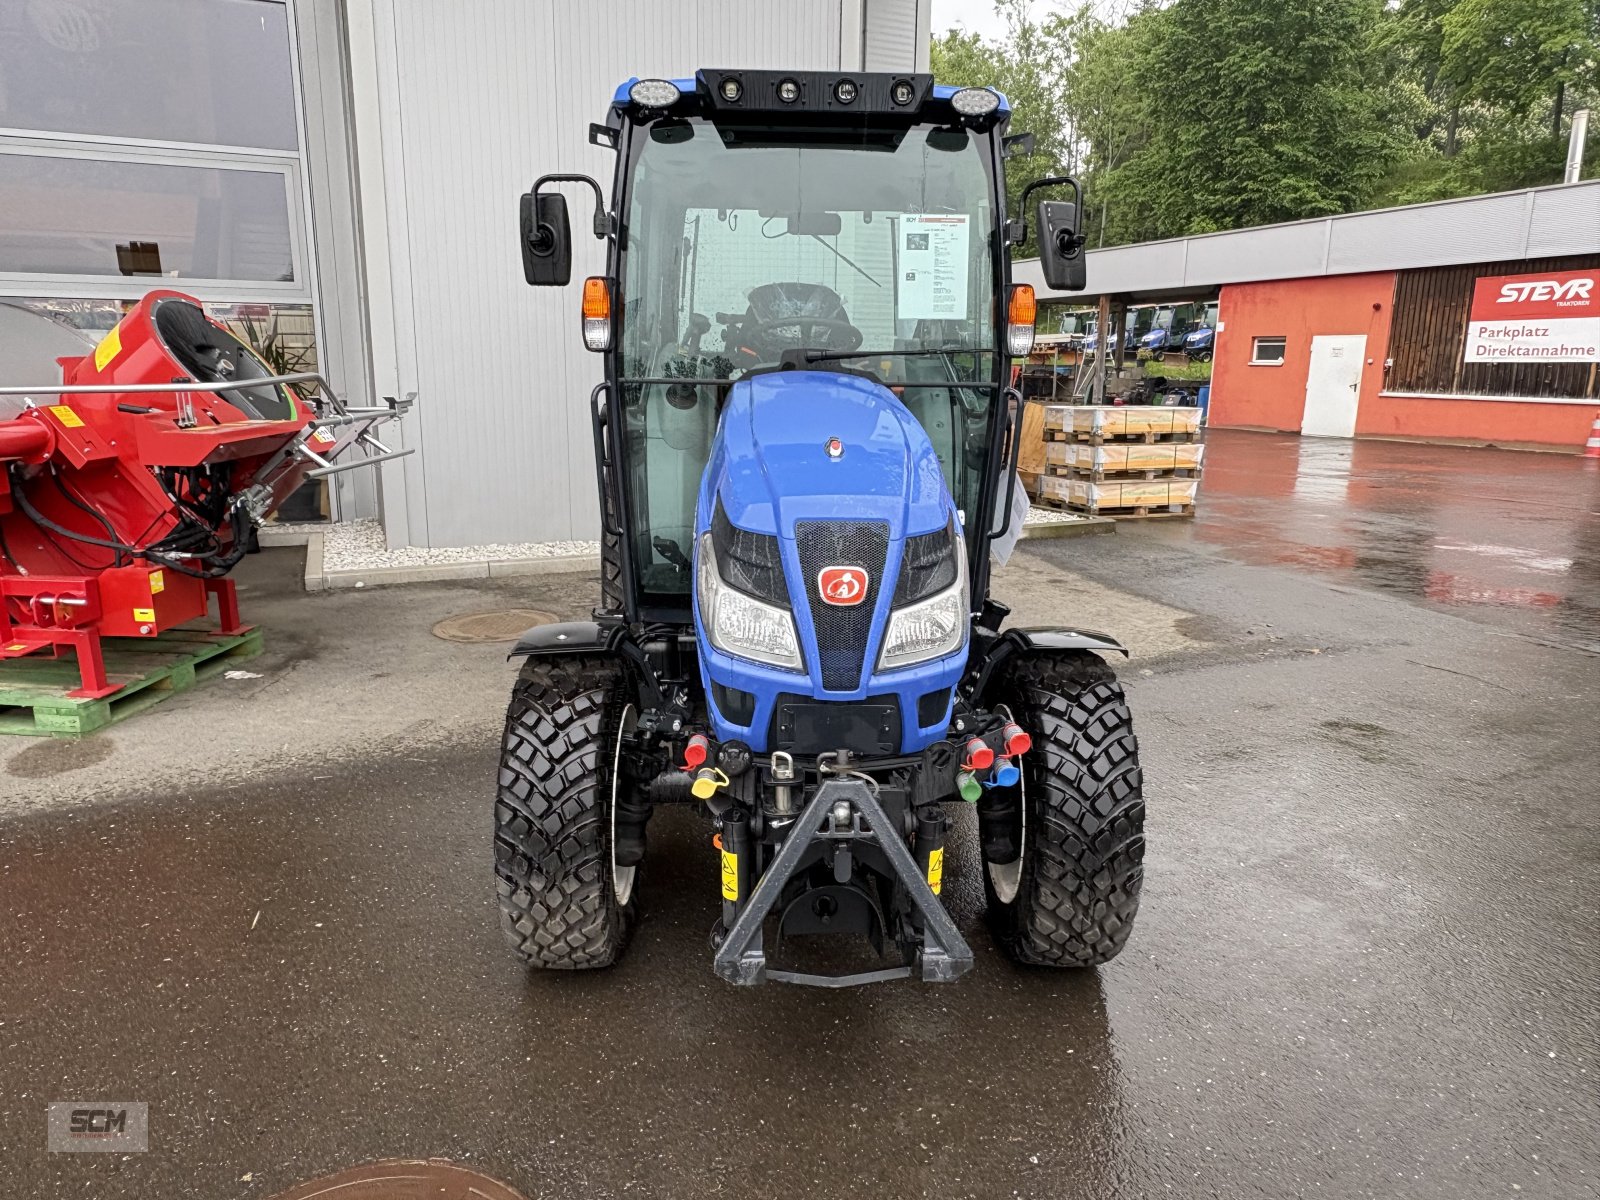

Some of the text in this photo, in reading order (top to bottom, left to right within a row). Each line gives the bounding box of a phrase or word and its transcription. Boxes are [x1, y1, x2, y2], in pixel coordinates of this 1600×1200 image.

[1496, 278, 1595, 303] STEYR
[1556, 300, 1591, 308] TRAKTOREN
[1478, 325, 1549, 341] Parkplatz
[1476, 343, 1596, 357] Direktannahme
